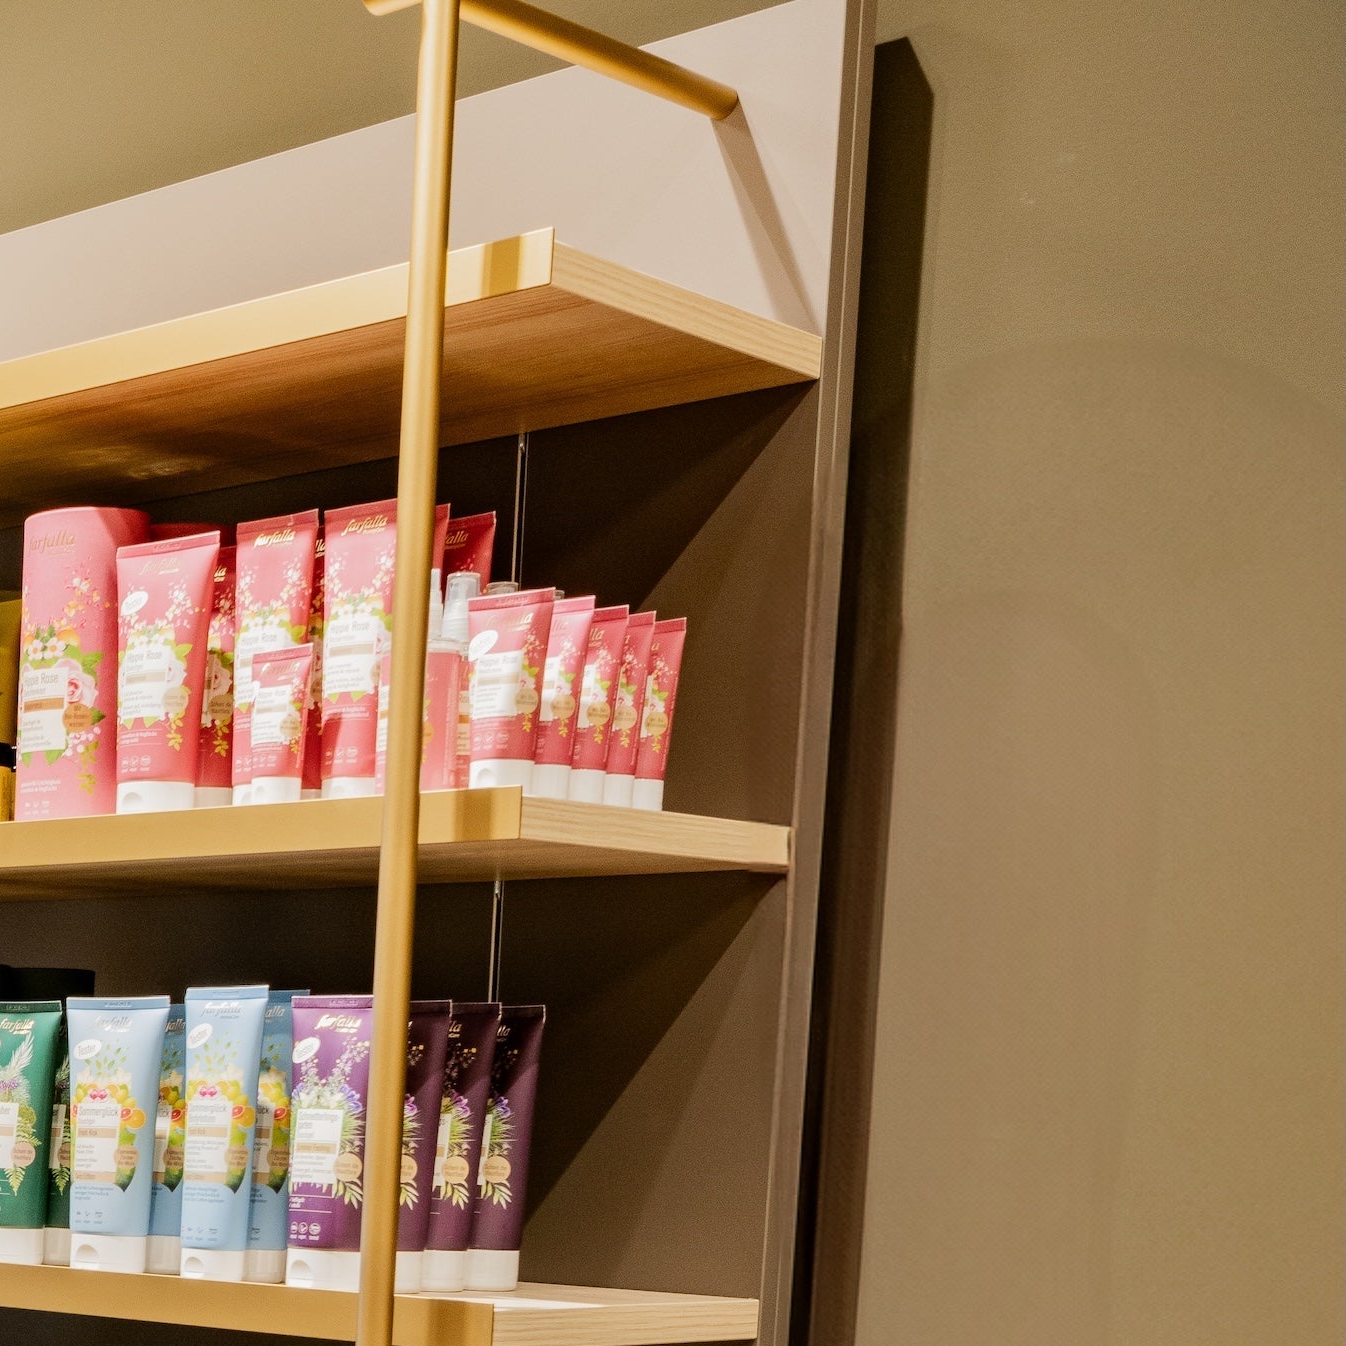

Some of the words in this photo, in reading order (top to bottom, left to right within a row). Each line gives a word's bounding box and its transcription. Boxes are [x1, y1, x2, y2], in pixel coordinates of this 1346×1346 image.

[341, 514, 389, 536] farfalla
[253, 528, 297, 547] farfalla
[41, 671, 59, 684] Rose
[79, 1105, 119, 1118] Sommerglück
